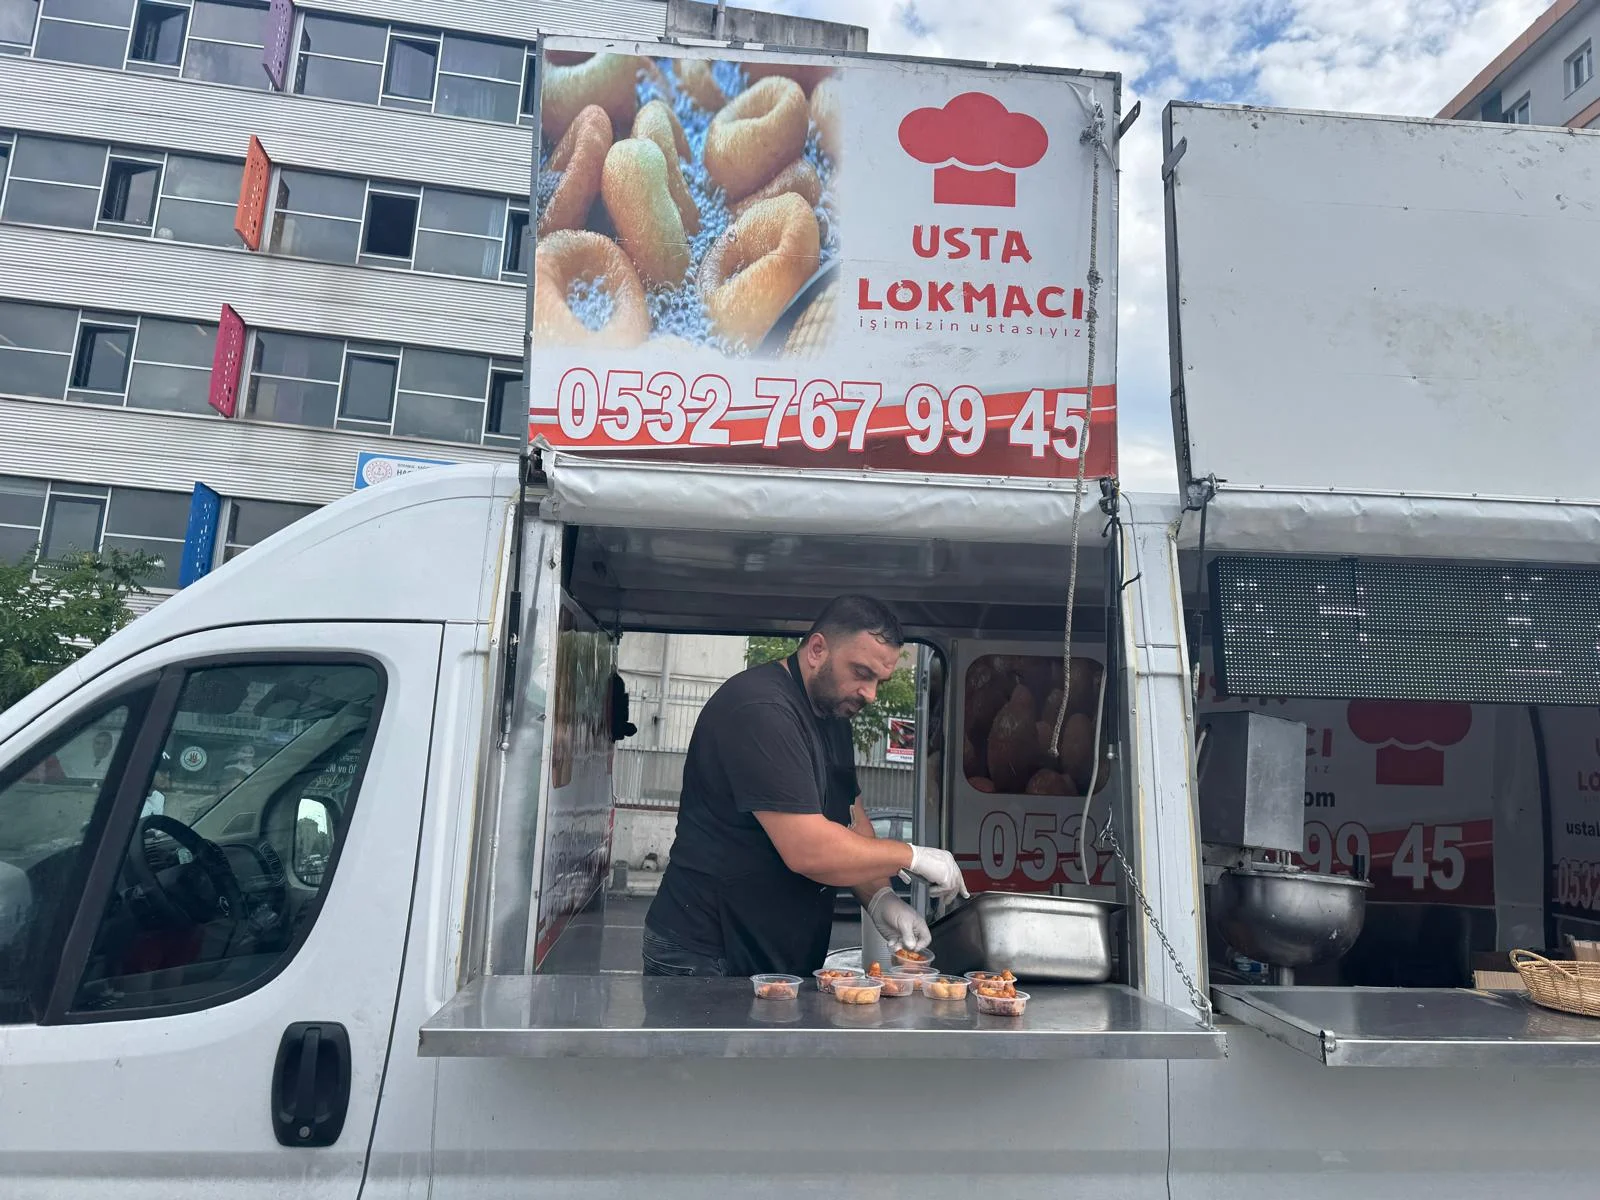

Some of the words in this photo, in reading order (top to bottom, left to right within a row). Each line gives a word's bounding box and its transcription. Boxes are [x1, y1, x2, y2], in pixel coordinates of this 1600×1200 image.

[912, 224, 1033, 264] USTA
[858, 278, 1084, 320] LOKMACI
[859, 316, 959, 332] işimizin
[970, 322, 1081, 339] ustasıyız
[557, 367, 732, 446] 0532
[755, 377, 882, 452] 767
[904, 383, 987, 457] 99
[1008, 387, 1091, 461] 45
[1392, 822, 1466, 891] 45
